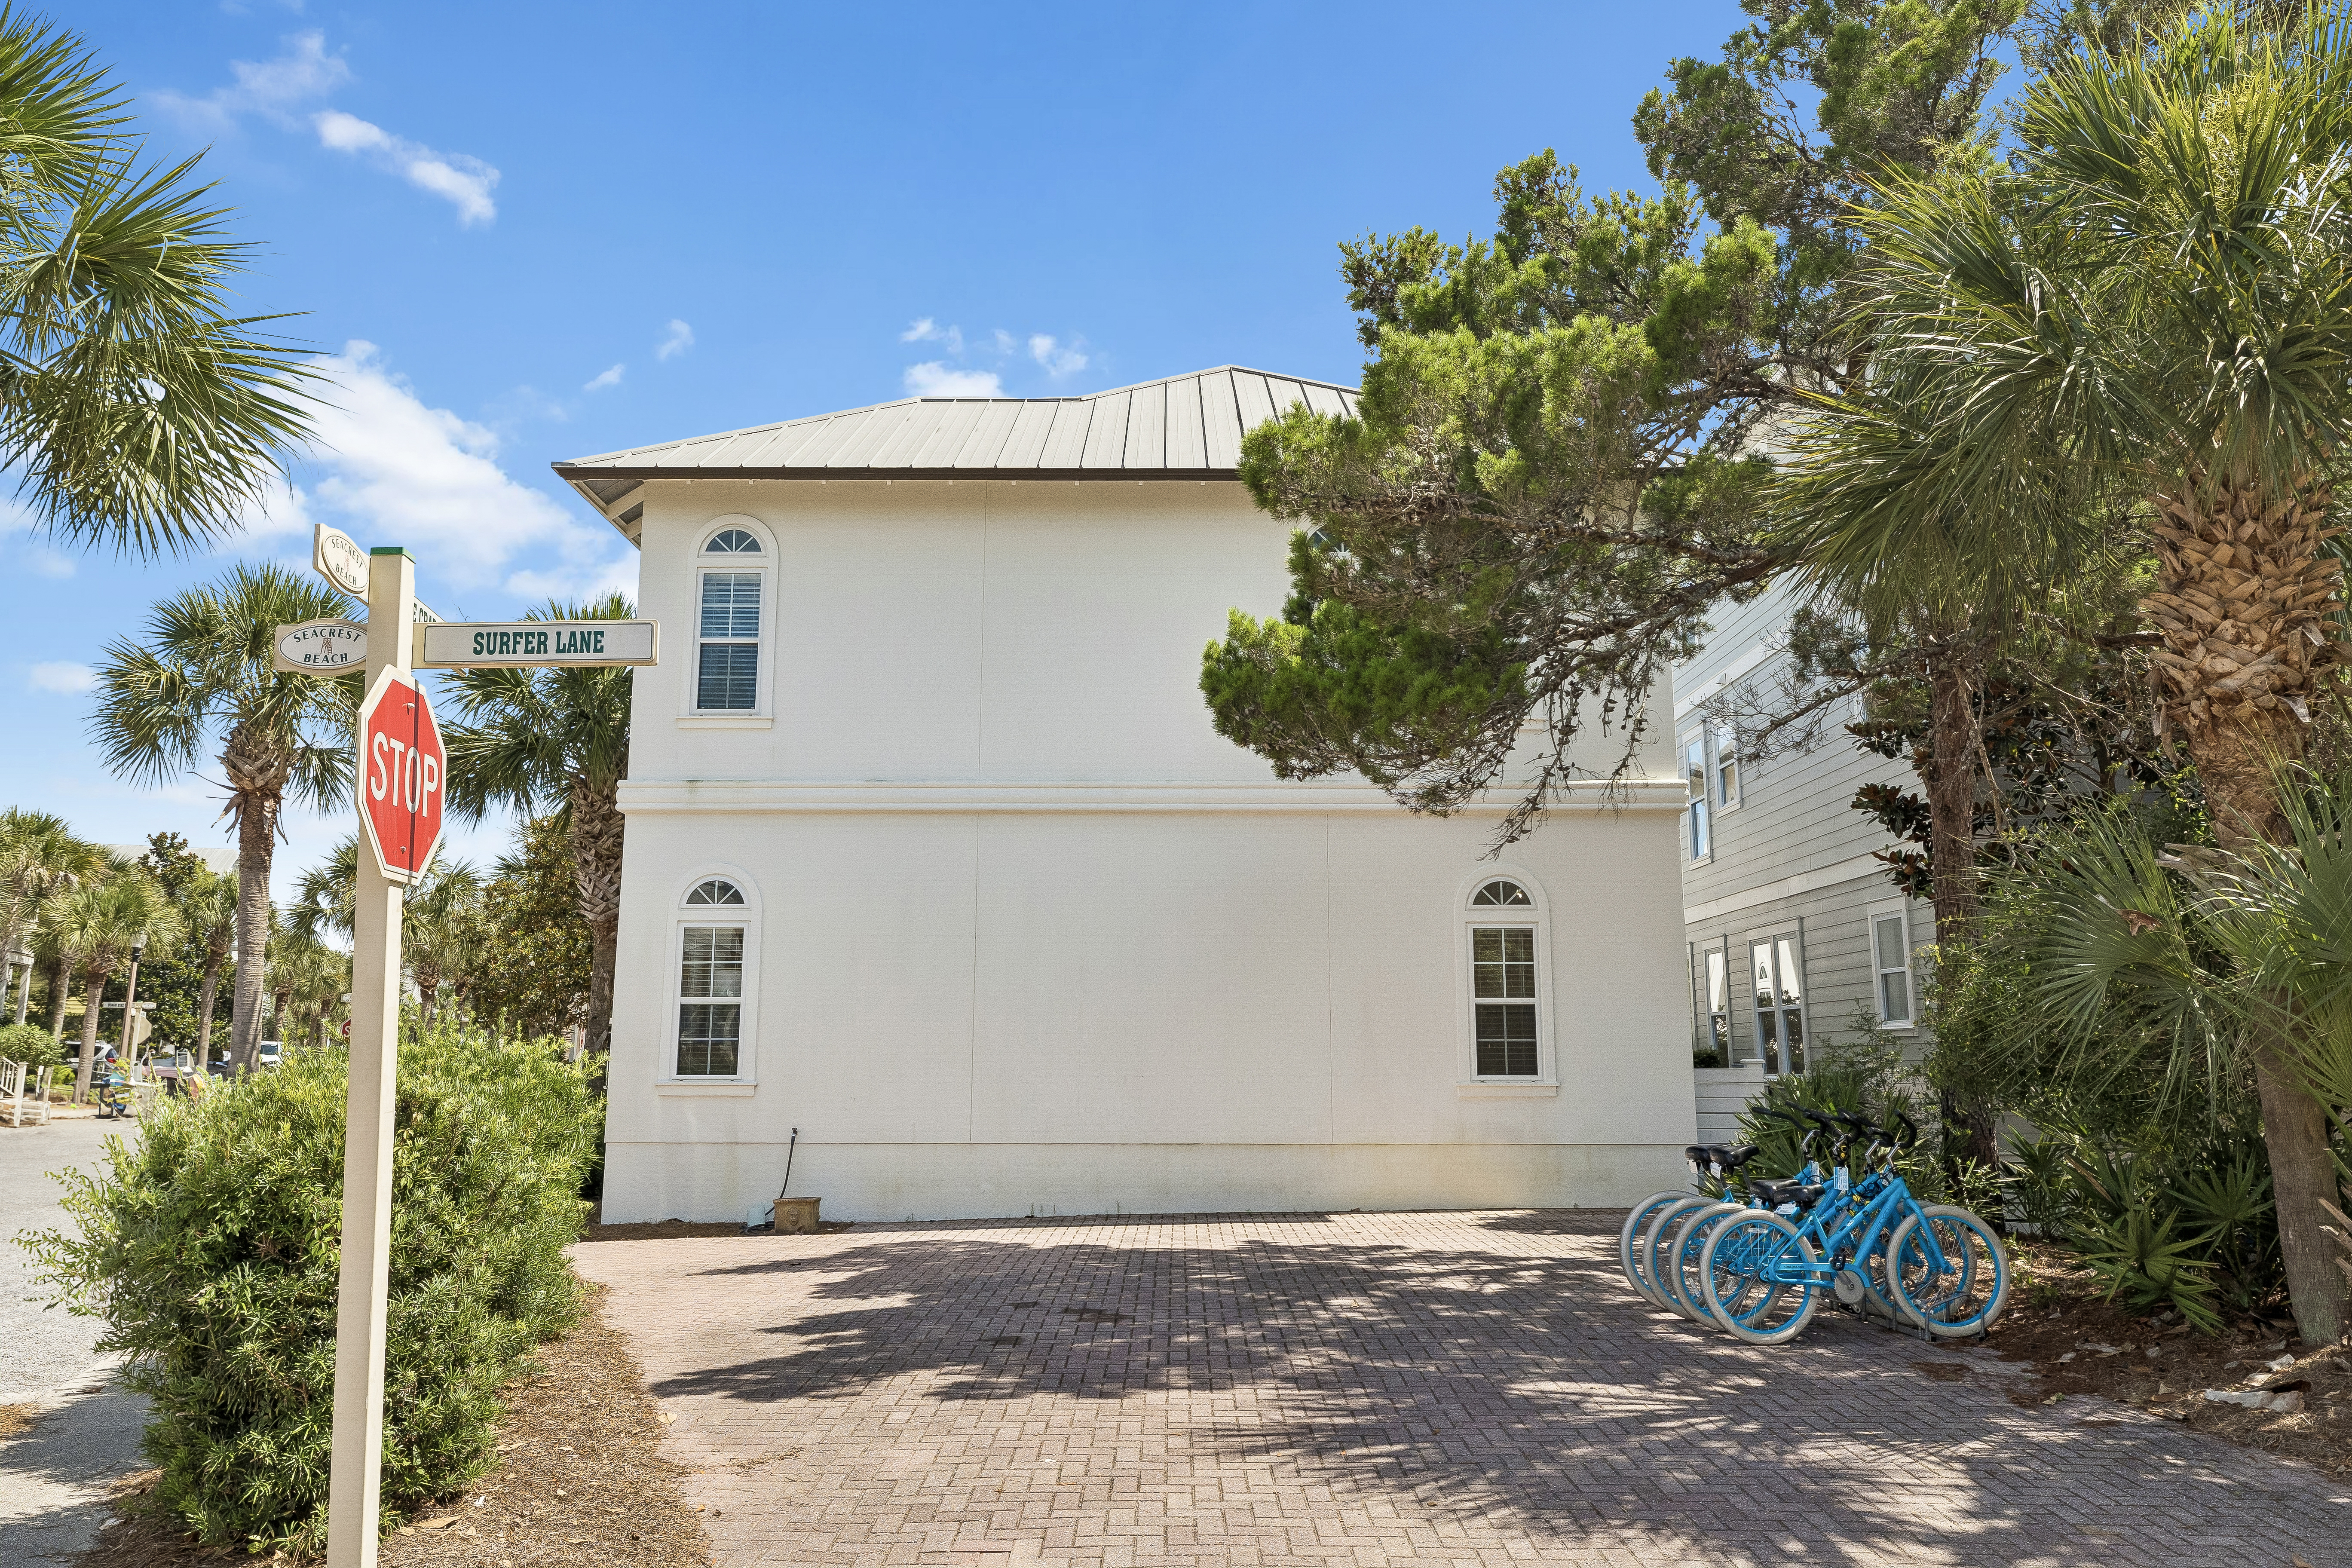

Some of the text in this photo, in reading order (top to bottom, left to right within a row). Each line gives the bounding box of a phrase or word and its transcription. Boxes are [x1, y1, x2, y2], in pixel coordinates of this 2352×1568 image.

[331, 538, 363, 568] SEACREST
[335, 563, 356, 586] BEACH
[293, 628, 361, 643] SEACREST
[473, 631, 604, 655] SURFER LANE
[303, 652, 348, 664] BEACH
[370, 731, 439, 818] STOP
